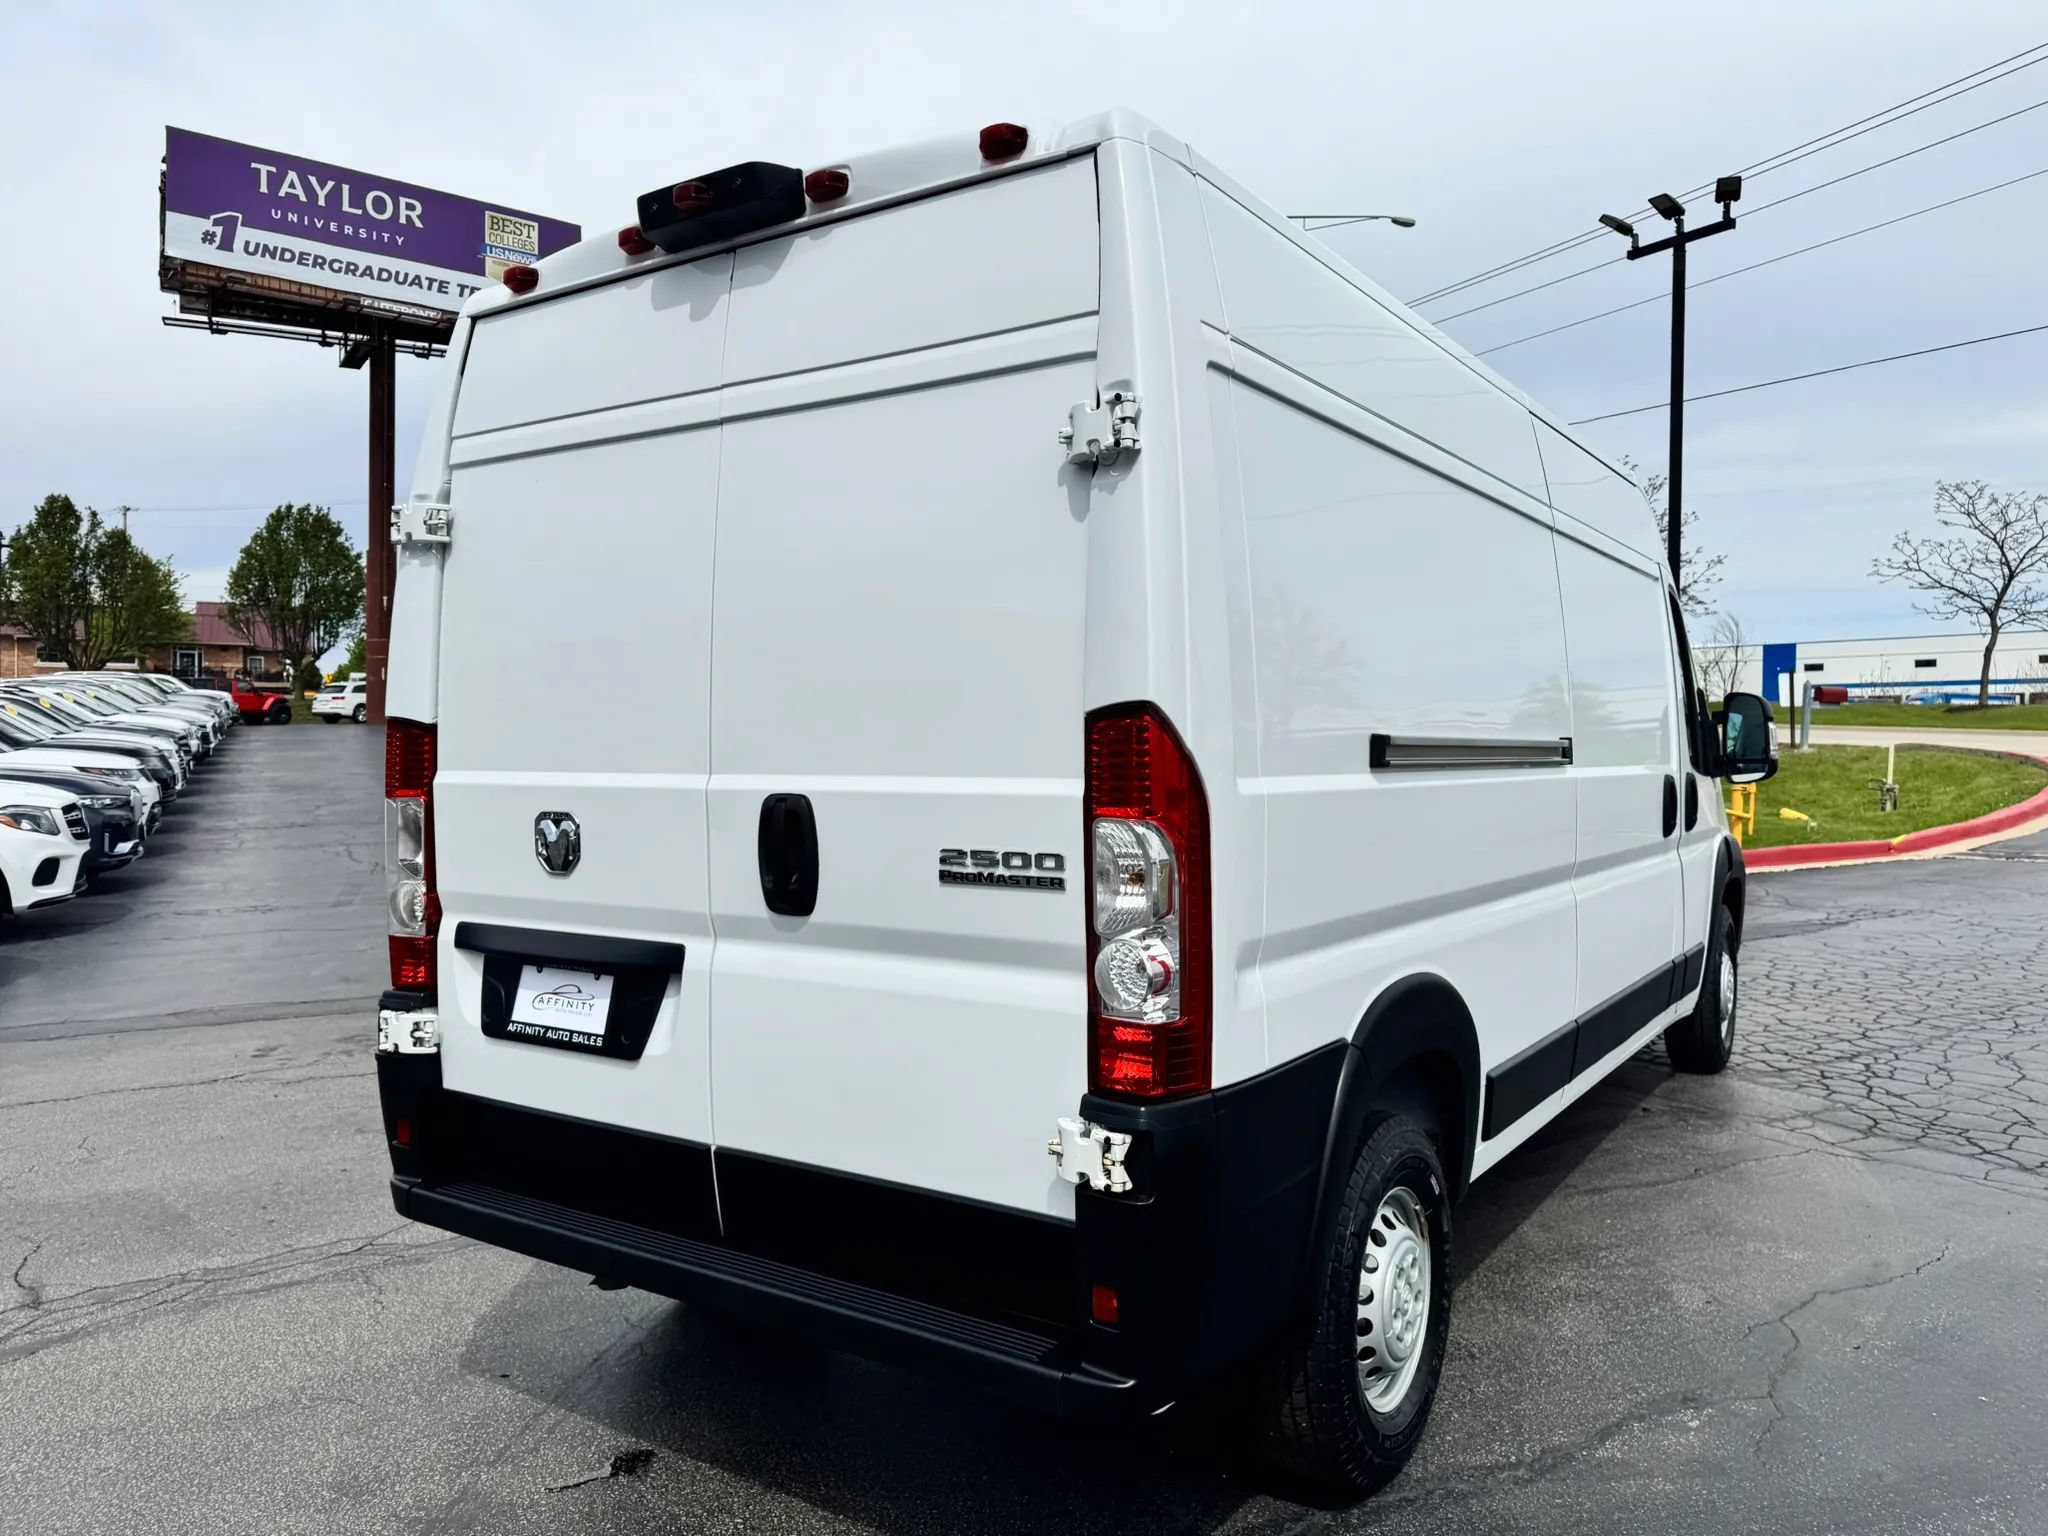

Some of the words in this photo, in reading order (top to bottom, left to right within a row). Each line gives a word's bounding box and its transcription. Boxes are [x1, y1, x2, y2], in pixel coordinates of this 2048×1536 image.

[250, 162, 424, 228] TAYLOR
[271, 208, 405, 246] UNIVERSITY
[489, 214, 535, 239] BEST
[200, 212, 242, 253] #1
[243, 240, 451, 294] UNDERGRADUATE
[489, 232, 535, 252] COLLEGES
[939, 848, 1066, 871] 2500
[939, 869, 1066, 891] PROMASTER
[537, 996, 595, 1012] AFFINITY
[507, 1022, 546, 1037] AFFINITY
[545, 1029, 570, 1041] AUTO
[571, 1033, 604, 1047] SALES
